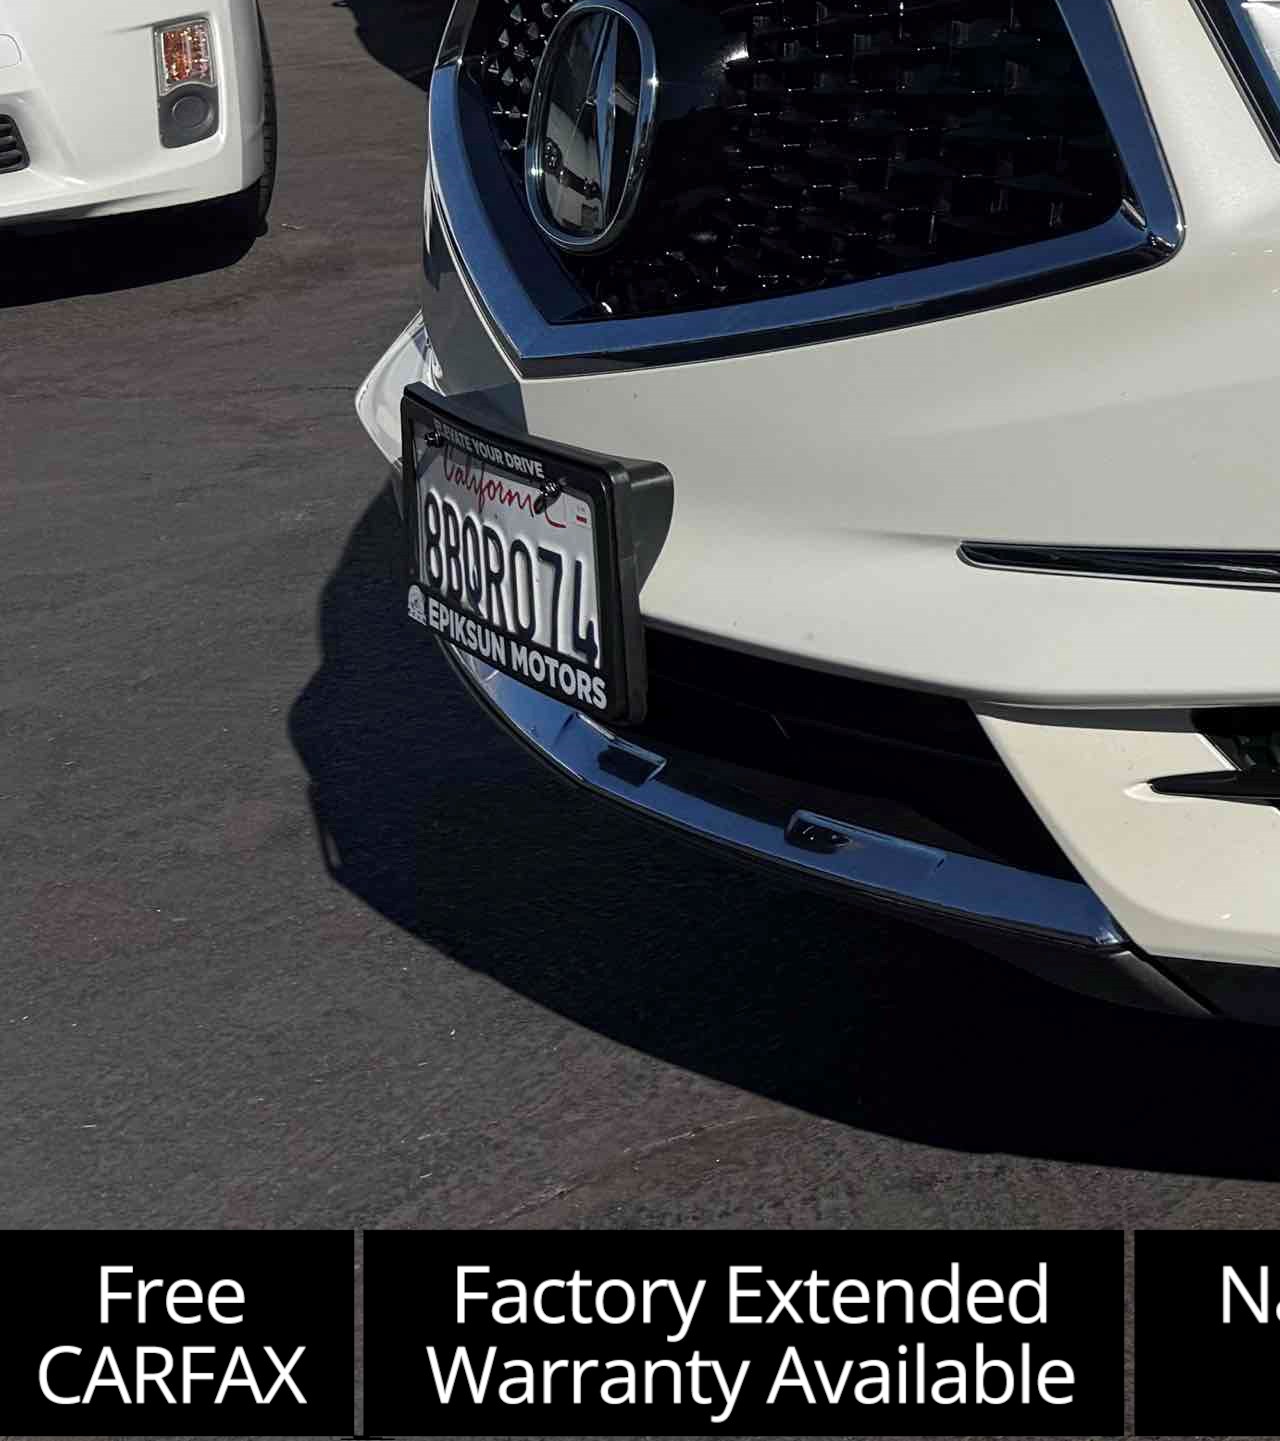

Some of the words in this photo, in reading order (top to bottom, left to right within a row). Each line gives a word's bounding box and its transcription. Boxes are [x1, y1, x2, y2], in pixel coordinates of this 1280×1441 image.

[443, 444, 567, 529] Californi
[472, 438, 504, 465] YOUR
[503, 450, 546, 480] DRIVE
[428, 597, 506, 667] EPIKSUN
[509, 639, 608, 711] MOTORS
